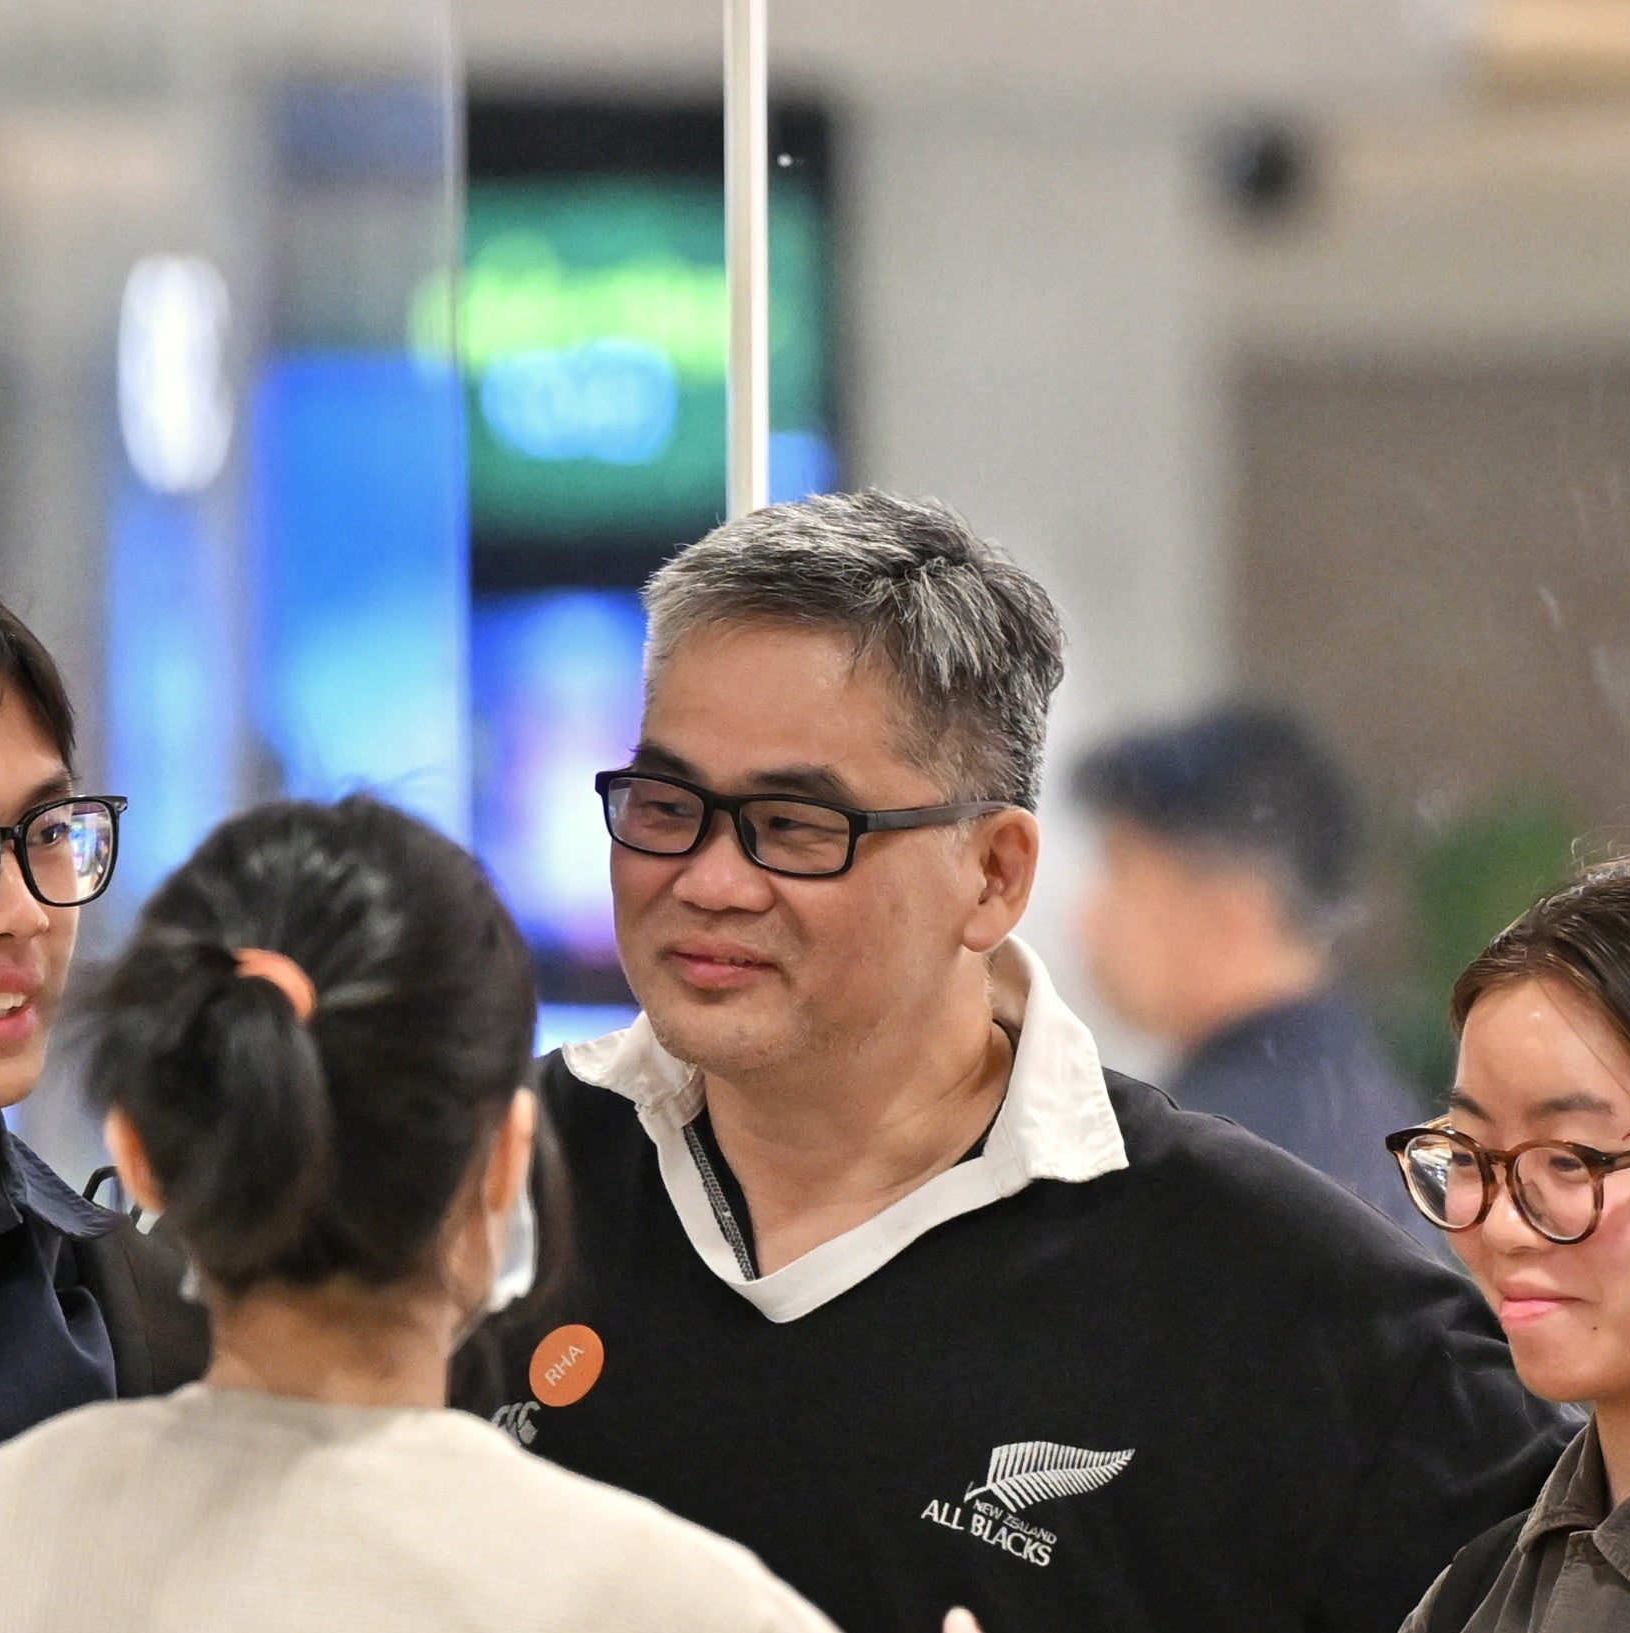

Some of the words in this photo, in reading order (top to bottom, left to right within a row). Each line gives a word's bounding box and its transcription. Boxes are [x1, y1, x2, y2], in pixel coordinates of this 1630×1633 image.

[544, 1345, 585, 1387] RHA
[921, 1499, 965, 1530] ALL
[970, 1513, 1053, 1567] BLACKS
[973, 1499, 1004, 1519] NEW
[1003, 1513, 1057, 1545] ZEALAND
